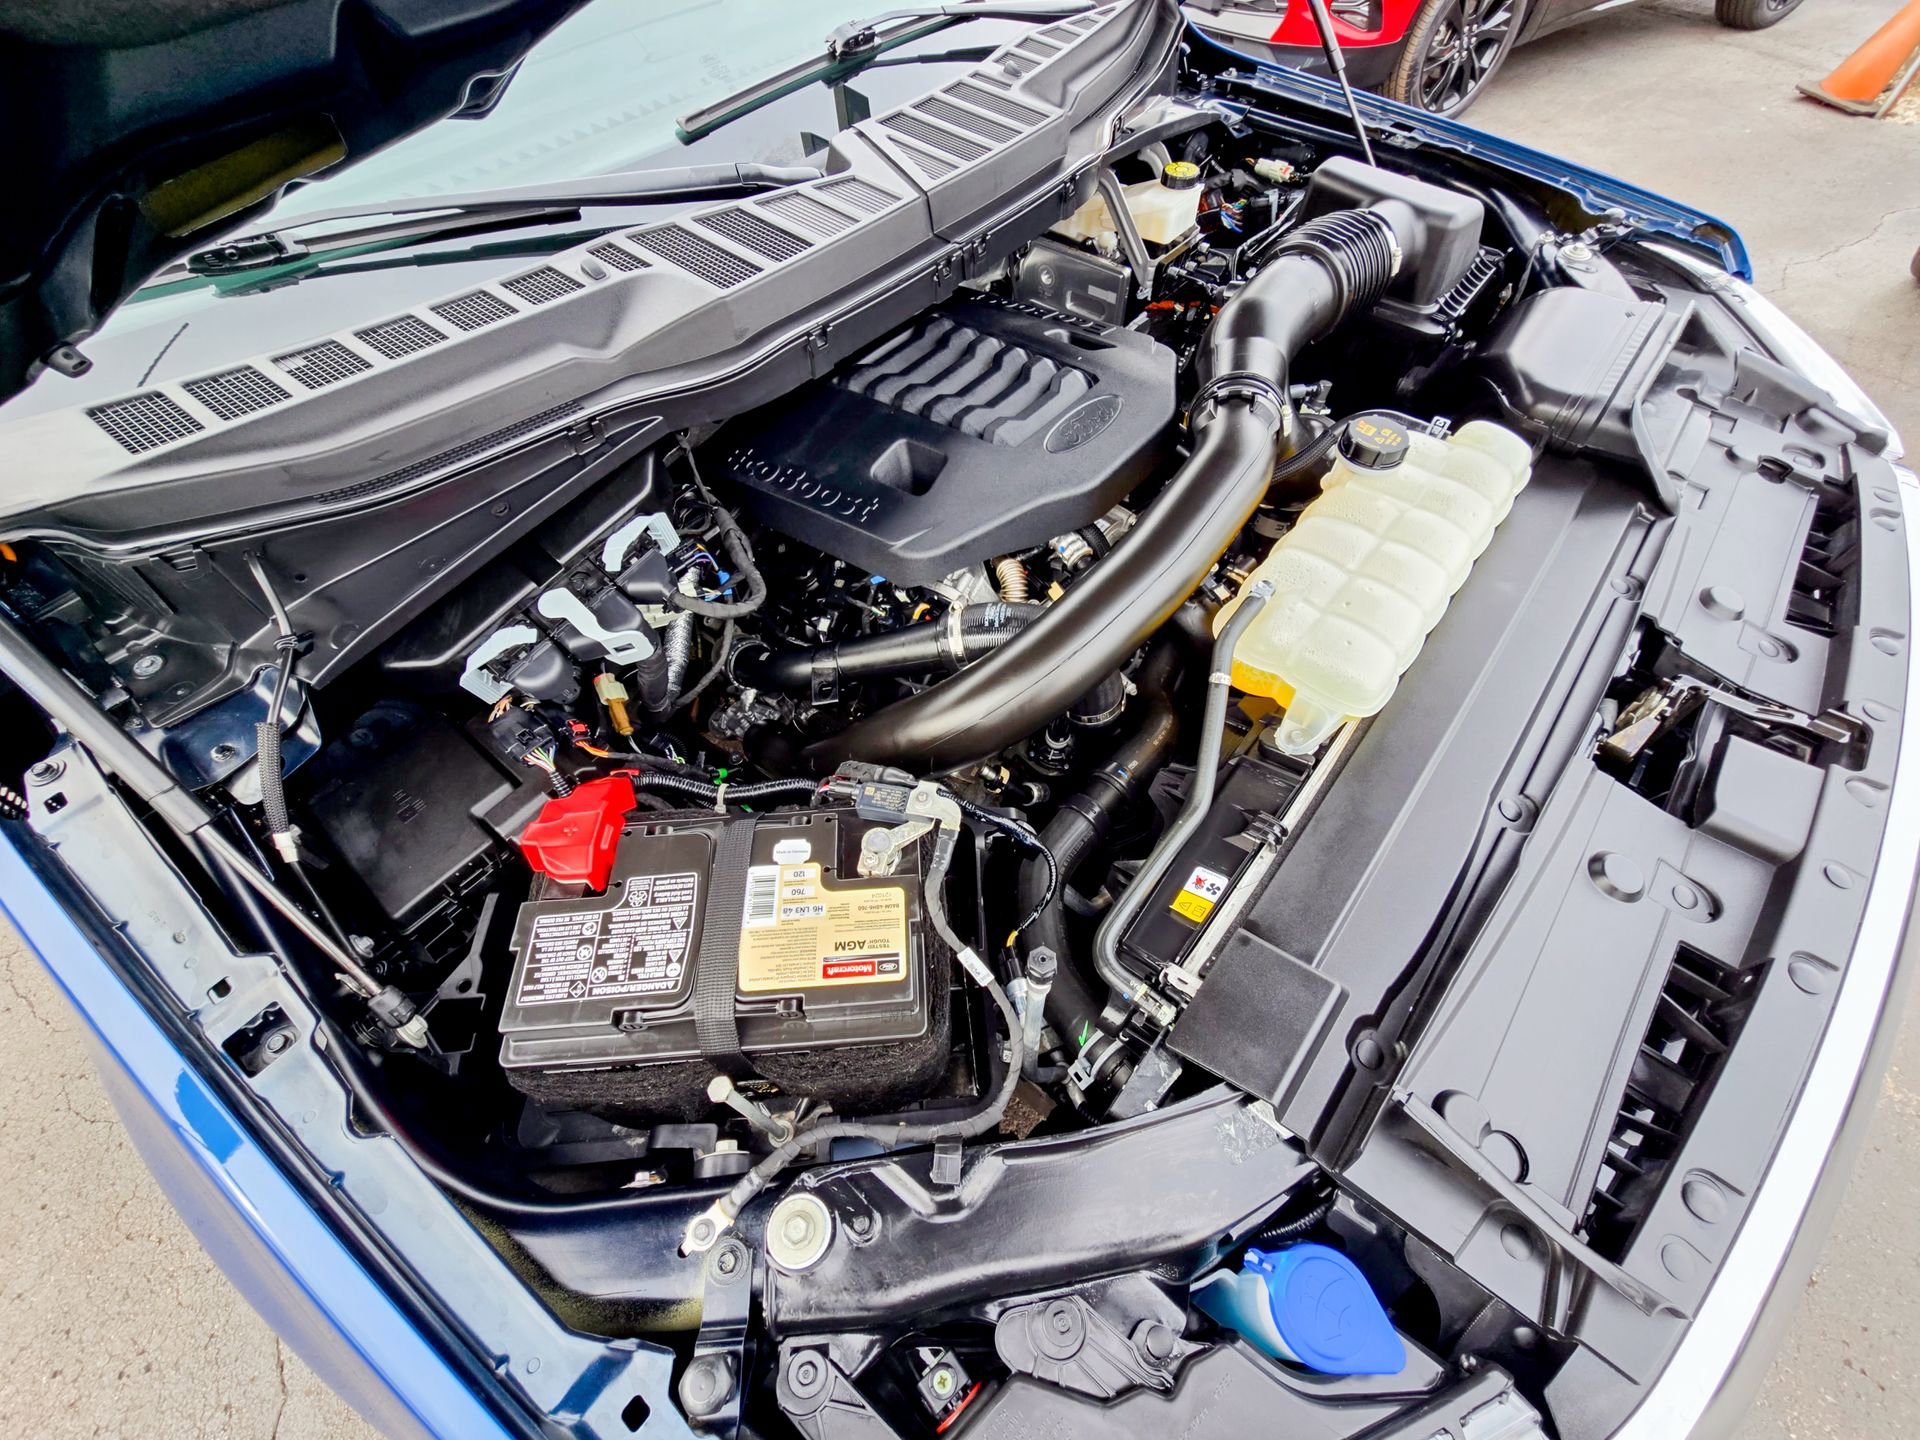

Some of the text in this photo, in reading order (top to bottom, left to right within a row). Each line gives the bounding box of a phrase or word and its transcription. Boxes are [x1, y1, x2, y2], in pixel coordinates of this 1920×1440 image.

[834, 940, 866, 951] AGM
[827, 964, 872, 975] Motorcraft
[592, 982, 667, 994] DANGER/POISON
